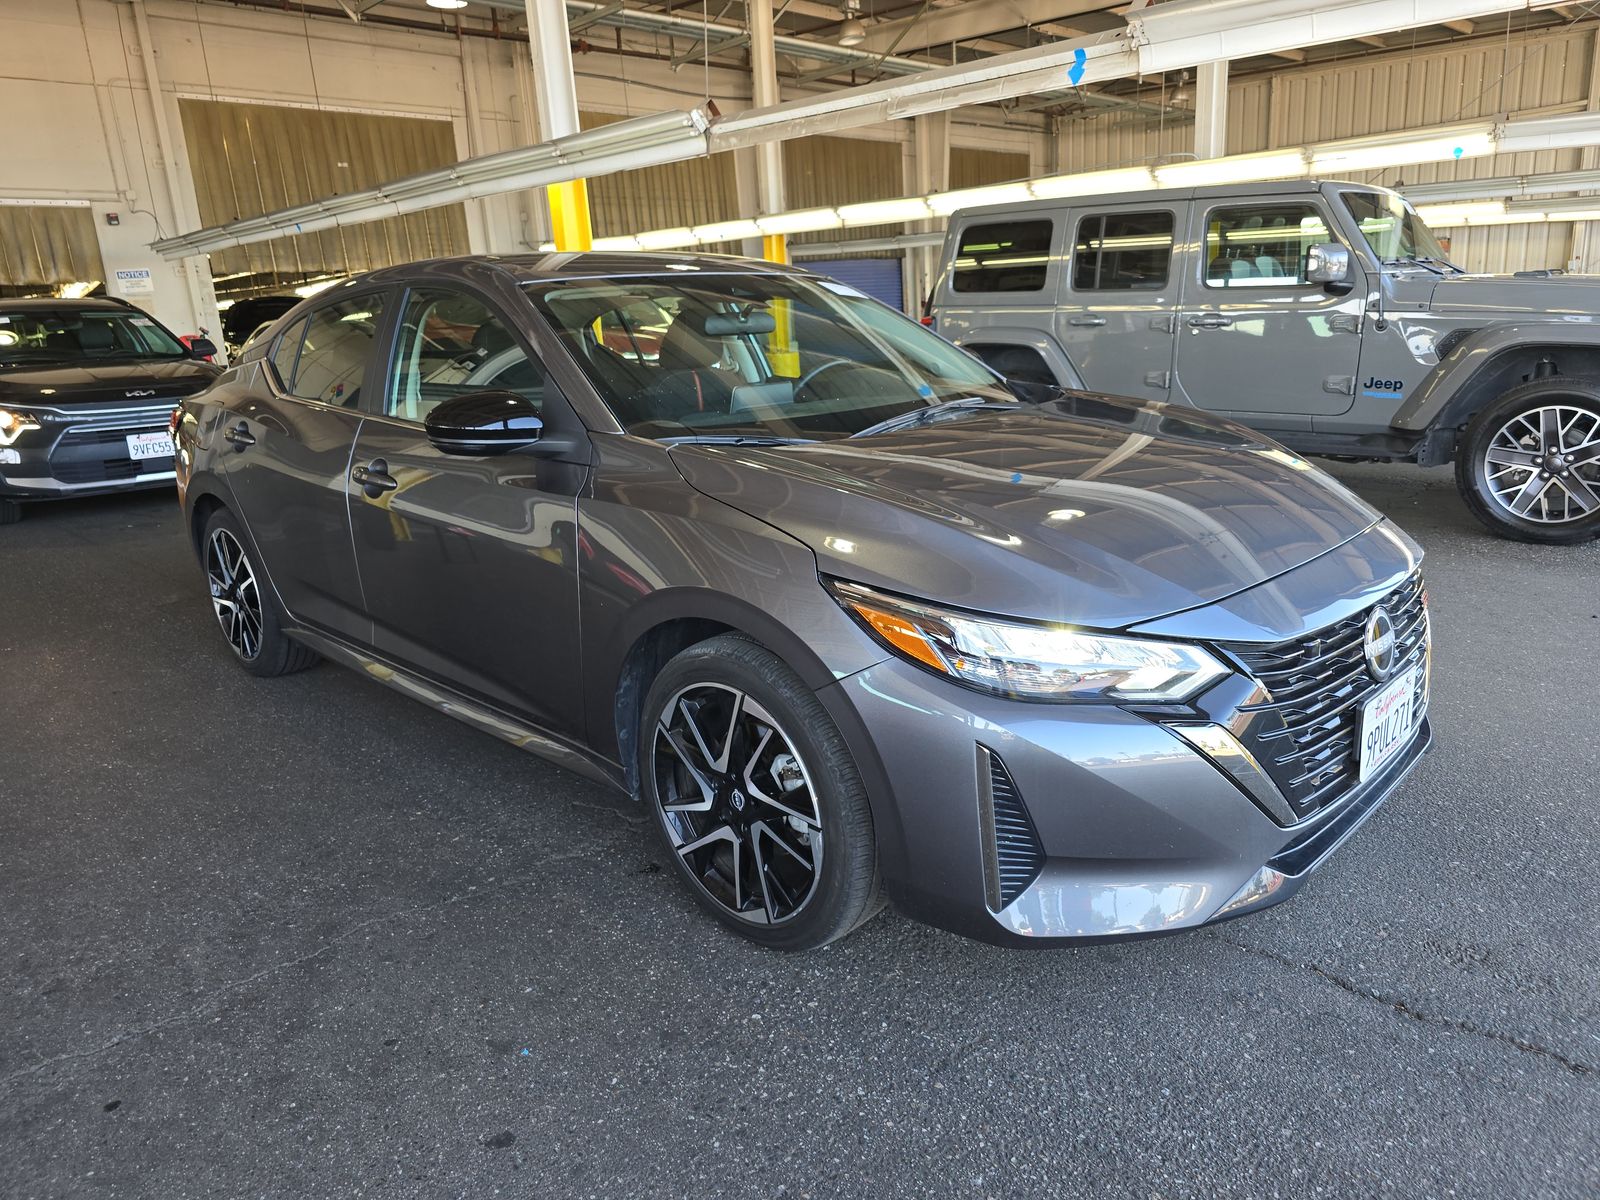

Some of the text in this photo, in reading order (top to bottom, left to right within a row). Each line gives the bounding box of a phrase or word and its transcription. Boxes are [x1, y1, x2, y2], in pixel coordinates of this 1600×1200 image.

[118, 271, 148, 279] NOTICE
[1363, 376, 1403, 392] Jeep
[132, 441, 176, 456] 9VFC55
[1366, 698, 1410, 768] 9PUL271
